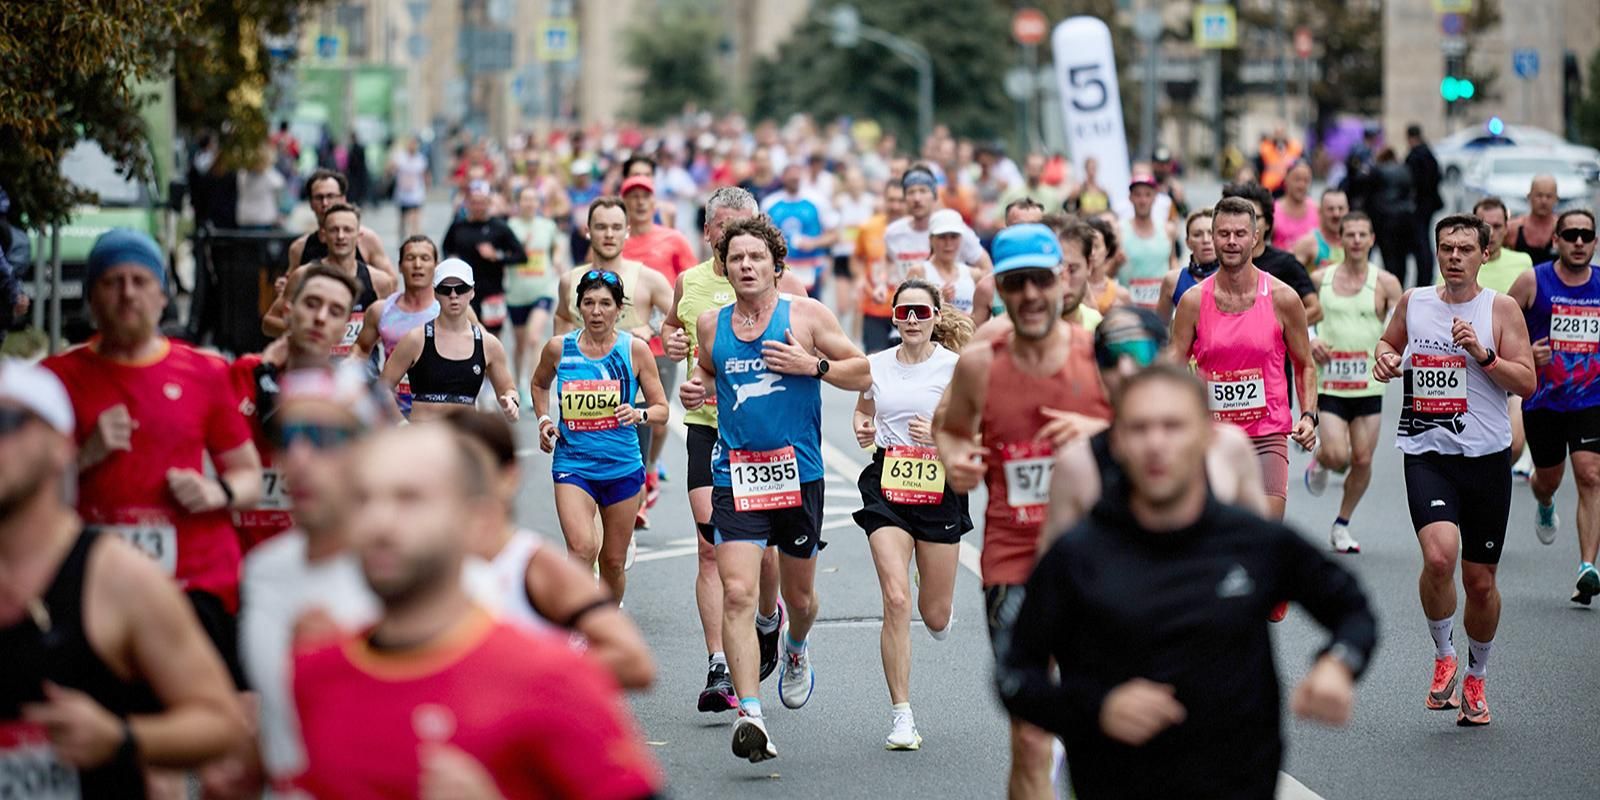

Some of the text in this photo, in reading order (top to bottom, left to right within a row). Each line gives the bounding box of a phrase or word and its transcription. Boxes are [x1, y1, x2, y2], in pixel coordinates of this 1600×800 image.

[1069, 65, 1107, 112] 5
[1553, 317, 1599, 334] 22813
[725, 358, 768, 374] БЕГО
[1417, 370, 1459, 388] 3886
[1214, 382, 1258, 401] 5892
[565, 394, 619, 410] 17054
[1416, 400, 1422, 411] B
[769, 455, 778, 463] 10
[735, 462, 797, 485] 13355
[890, 460, 938, 481] 6313
[748, 484, 785, 492] АЛЕКСАНДР
[902, 480, 922, 488] ЕЛЕНА
[740, 498, 750, 510] B
